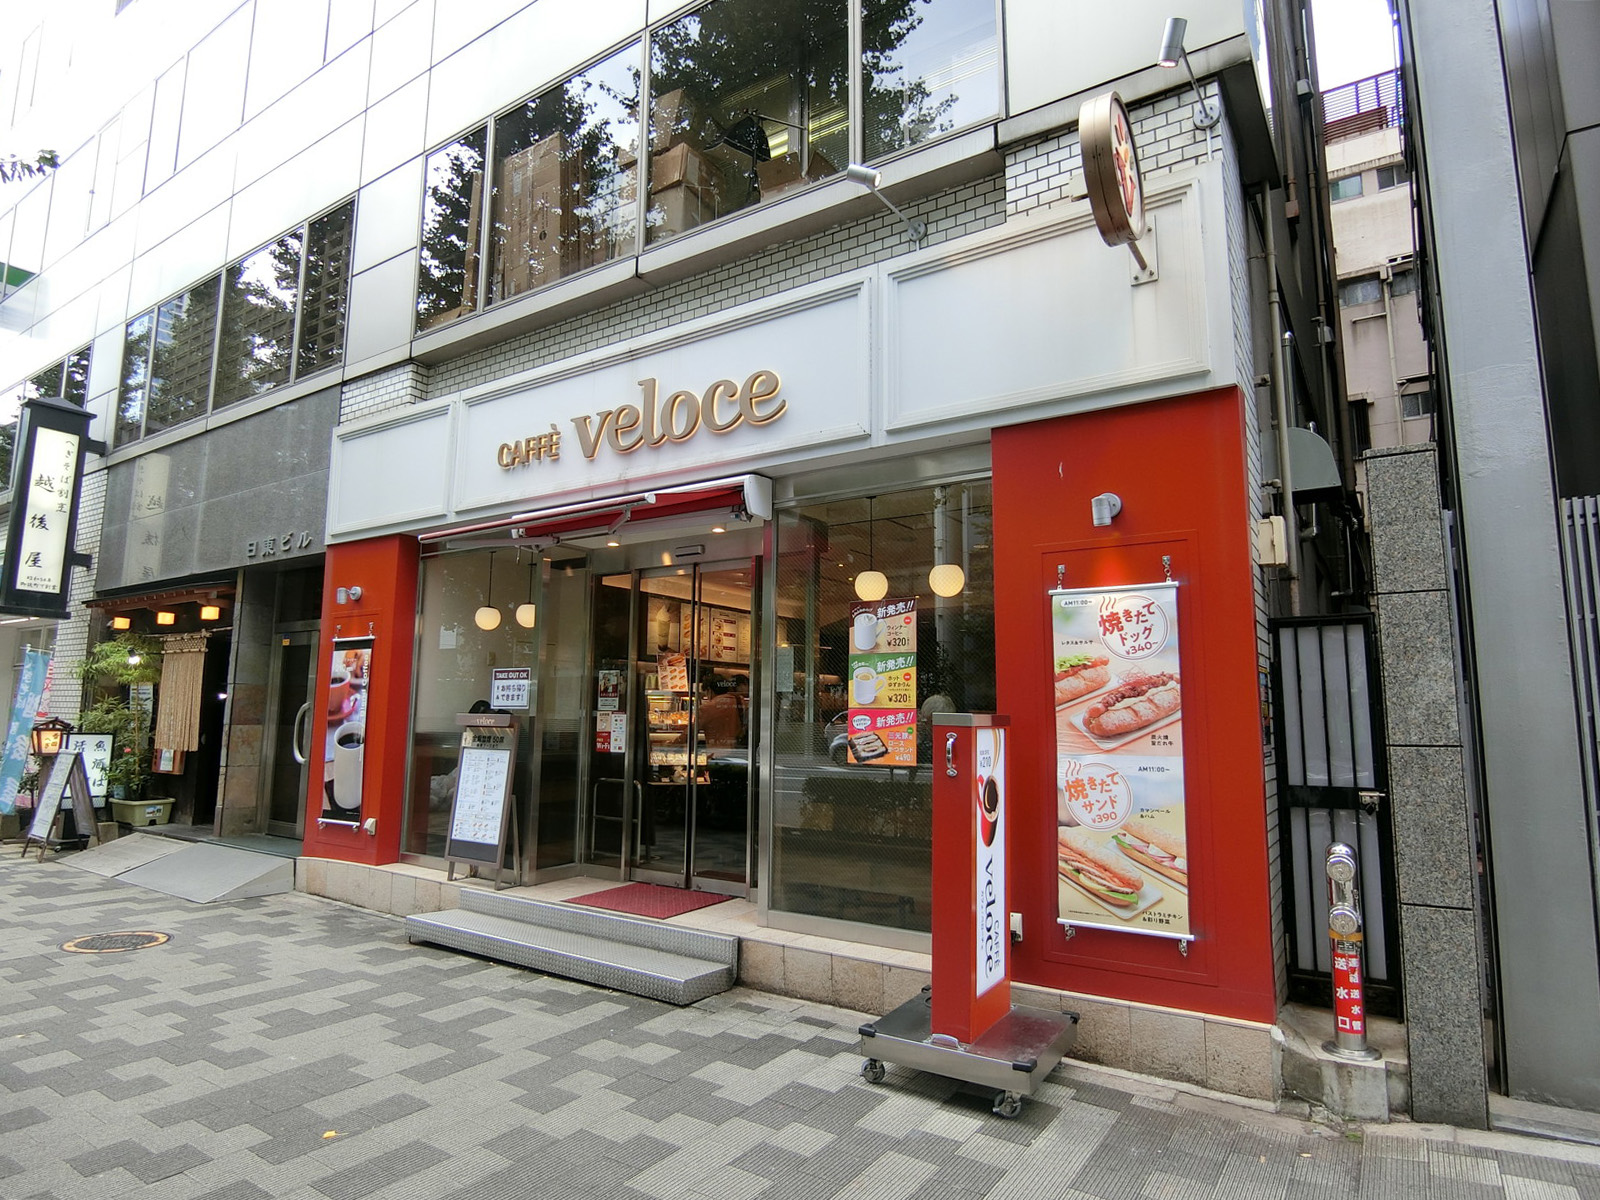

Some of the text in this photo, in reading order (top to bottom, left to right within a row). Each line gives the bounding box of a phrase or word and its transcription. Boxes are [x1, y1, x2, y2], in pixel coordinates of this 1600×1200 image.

[497, 369, 788, 470] CAFFÈ veloce
[24, 473, 56, 568] 越後屋
[247, 530, 313, 558] 日東ビル
[877, 600, 914, 619] 新発売!!
[1098, 601, 1155, 637] 焼きたて
[886, 637, 907, 647] ¥320
[1120, 623, 1154, 647] ドッグ
[876, 655, 914, 673] 新発売!!
[887, 693, 908, 703] ¥320
[876, 712, 914, 728] 新発売!!
[1064, 771, 1119, 802] 焼きたて
[1082, 795, 1117, 814] サンド
[1091, 811, 1117, 824] ¥390
[985, 854, 996, 979] veloce
[1334, 956, 1350, 1030] 送水口
